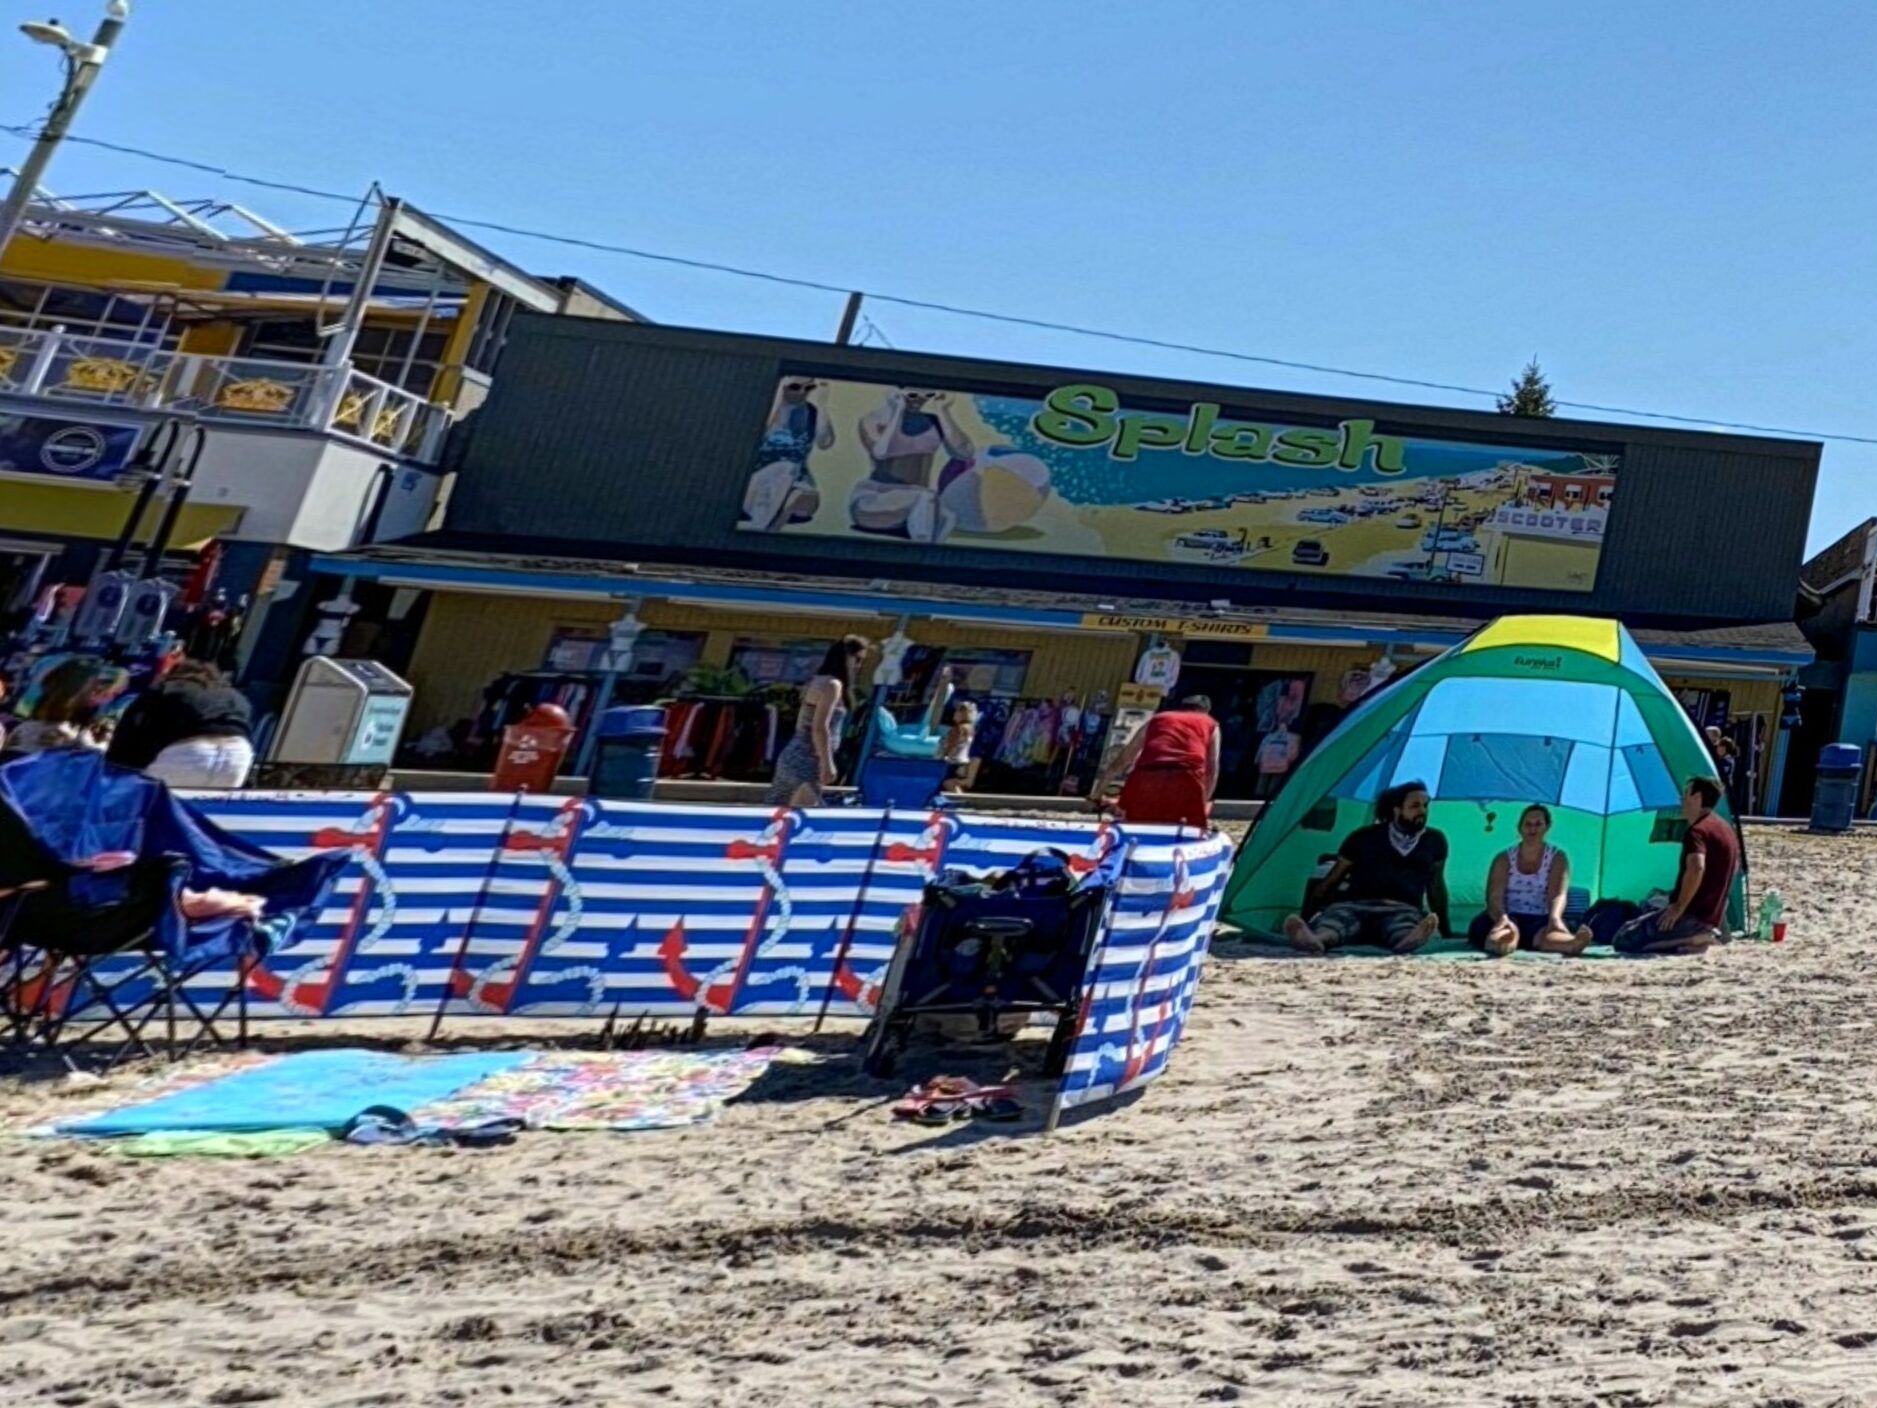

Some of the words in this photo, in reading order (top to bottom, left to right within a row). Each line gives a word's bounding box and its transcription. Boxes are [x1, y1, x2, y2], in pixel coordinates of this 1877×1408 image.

[1030, 383, 1406, 475] Splash
[1496, 510, 1602, 533] SCOOTER
[1099, 616, 1167, 629] CUSTOM
